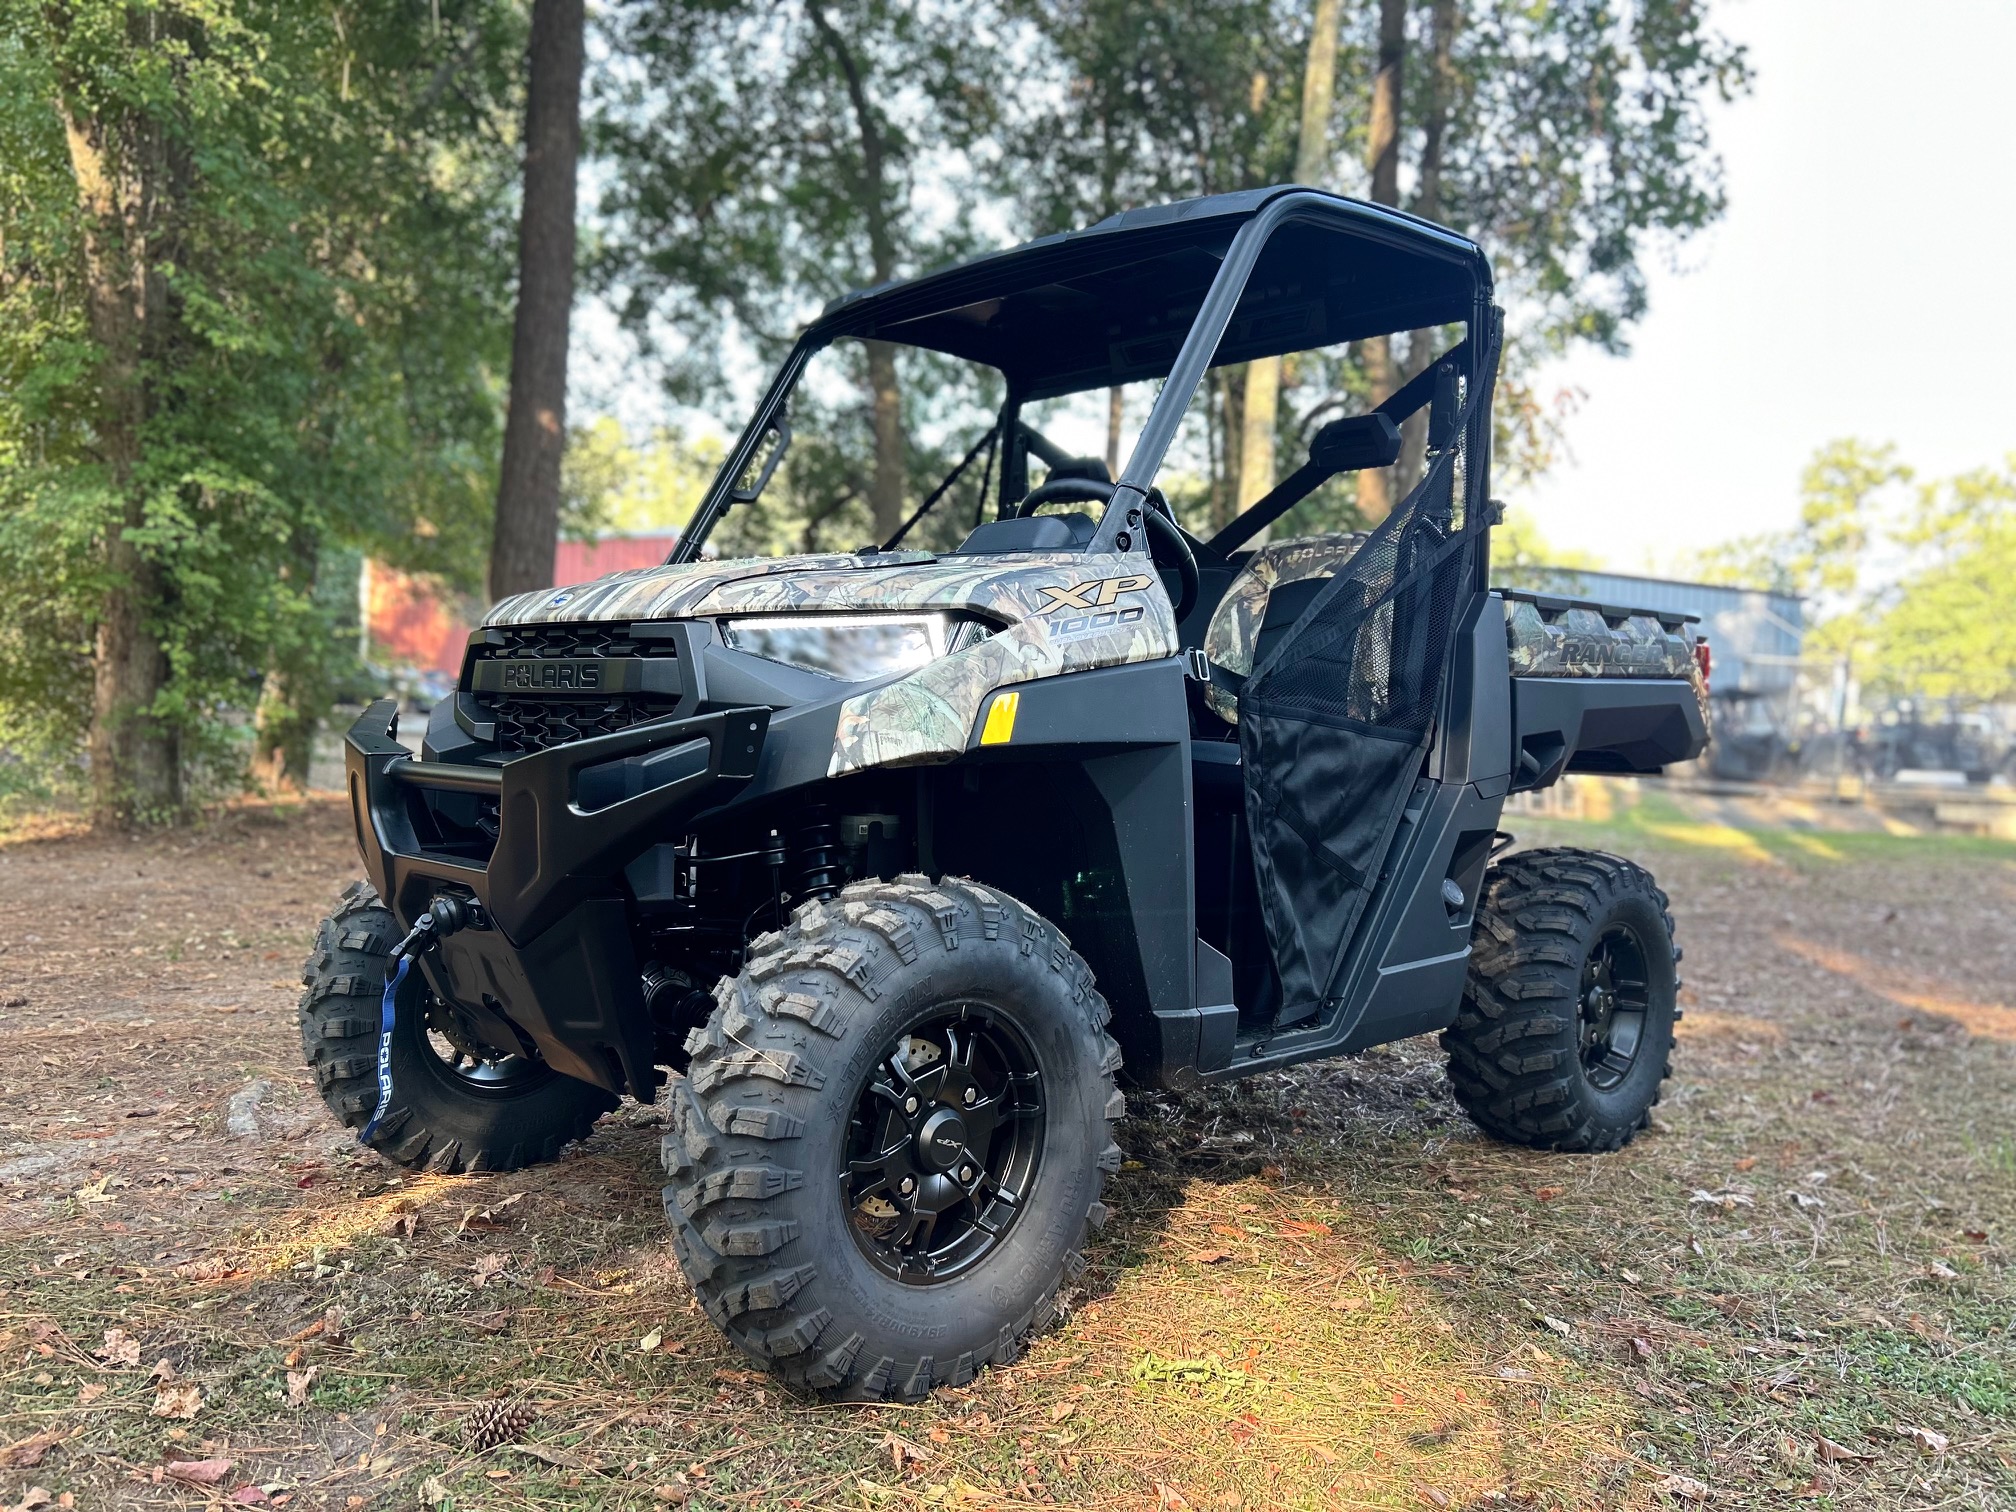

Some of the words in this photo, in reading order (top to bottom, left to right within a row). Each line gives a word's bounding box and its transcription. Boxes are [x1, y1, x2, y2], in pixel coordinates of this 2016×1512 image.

[1026, 573, 1155, 617] XP
[1048, 606, 1145, 637] 1000
[1559, 640, 1663, 666] RANGER
[503, 664, 599, 689] POLARIS
[374, 1031, 392, 1122] POLARIS
